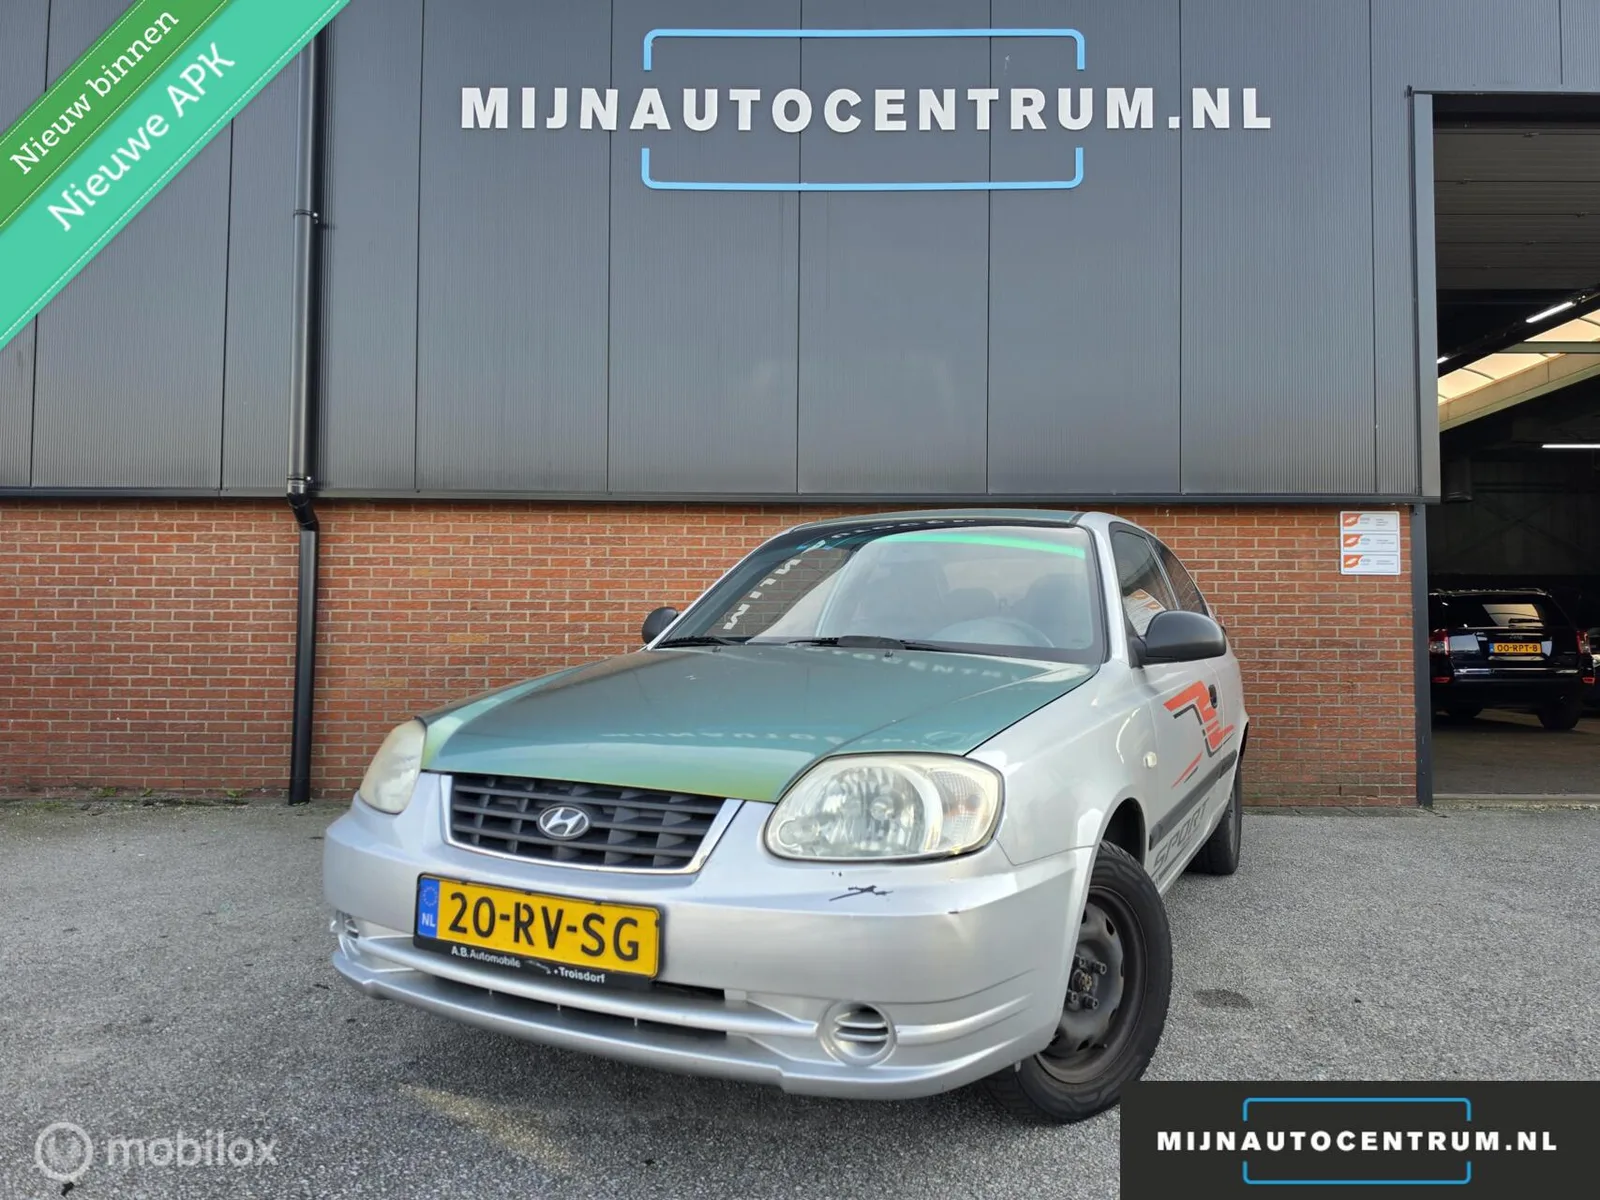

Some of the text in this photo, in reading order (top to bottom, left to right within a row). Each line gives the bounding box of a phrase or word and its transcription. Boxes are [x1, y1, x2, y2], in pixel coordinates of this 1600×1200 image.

[461, 86, 1272, 133] MIJNAUTOCENTRUM.NL
[421, 912, 436, 928] NL
[448, 891, 640, 962] 20-RV-SG
